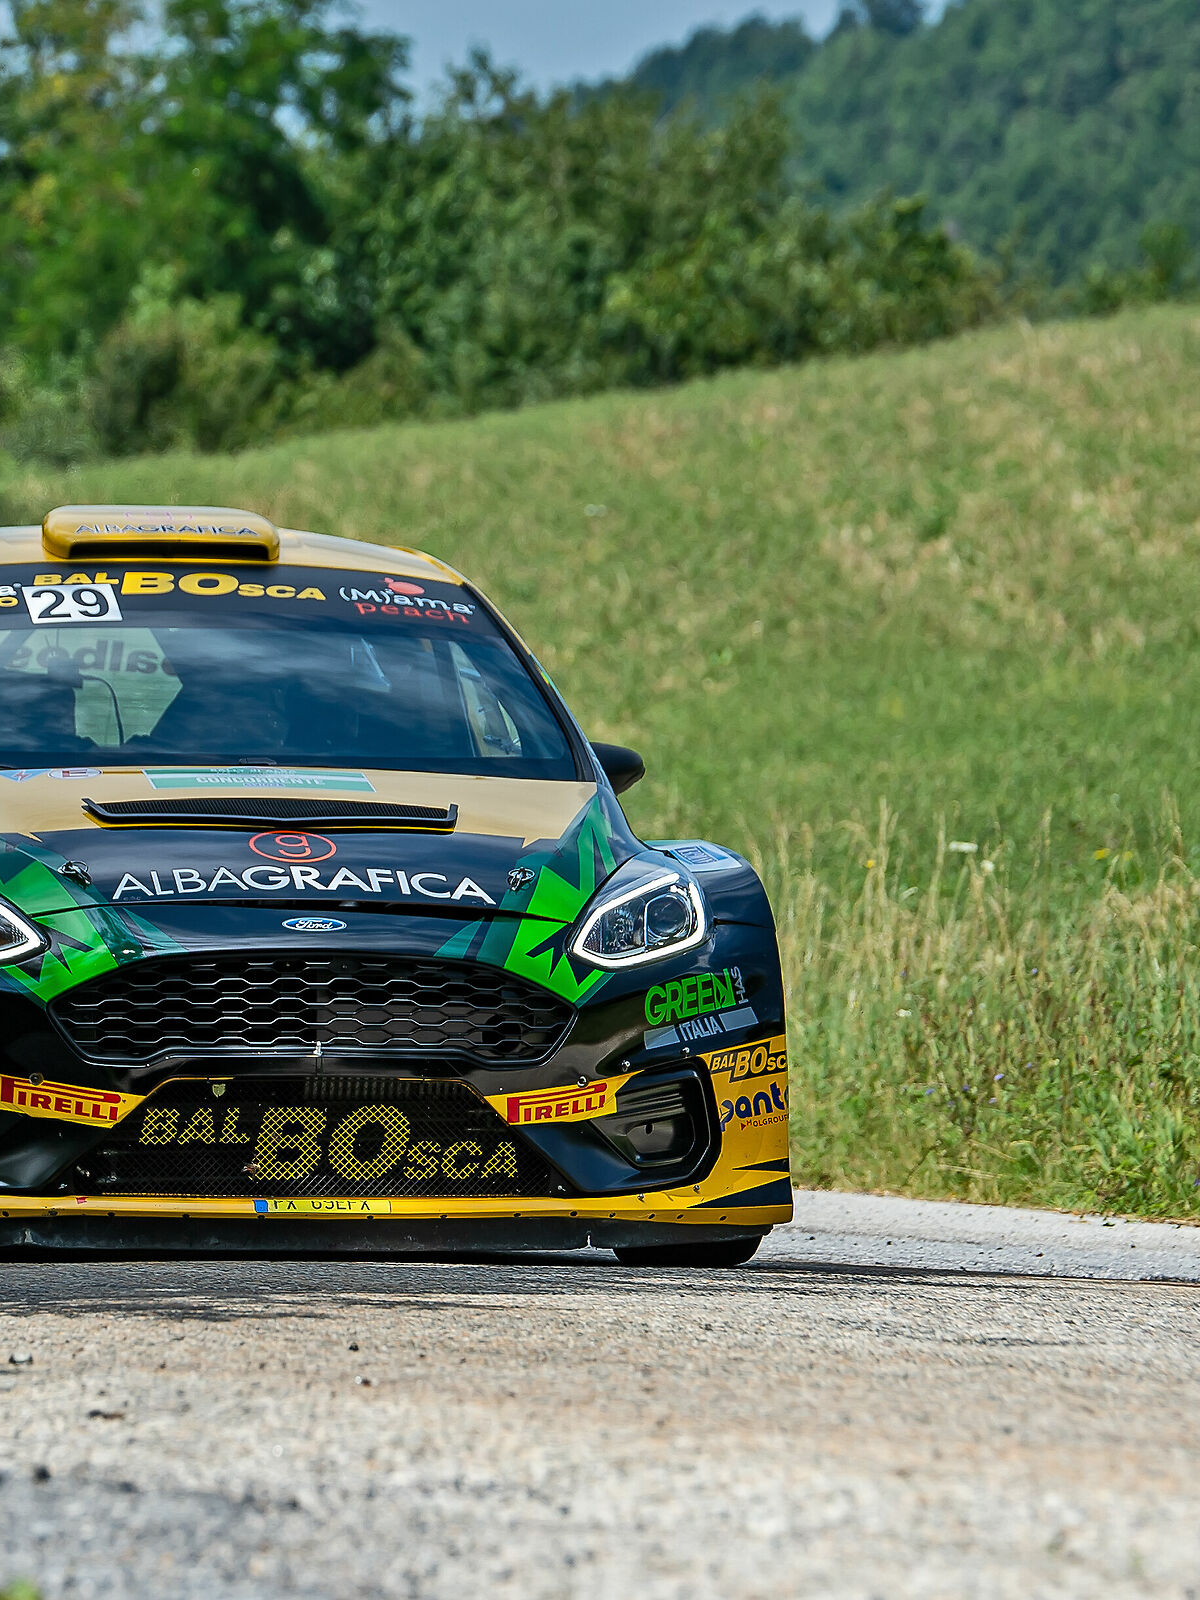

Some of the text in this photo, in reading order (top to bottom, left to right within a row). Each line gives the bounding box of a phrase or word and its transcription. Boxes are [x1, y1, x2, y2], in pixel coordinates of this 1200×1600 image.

[31, 588, 110, 619] 29
[33, 572, 326, 600] BALBOSCA
[354, 602, 470, 624] peach
[112, 865, 497, 905] ALBAGRAFICA
[295, 919, 333, 929] Ford
[645, 968, 736, 1025] GREEN
[731, 966, 749, 1004] HAS
[679, 1015, 723, 1041] ITALIA
[1, 1076, 121, 1121] PIRELLI
[507, 1083, 607, 1123] PIRELLI
[139, 1104, 518, 1180] BALBOSCA
